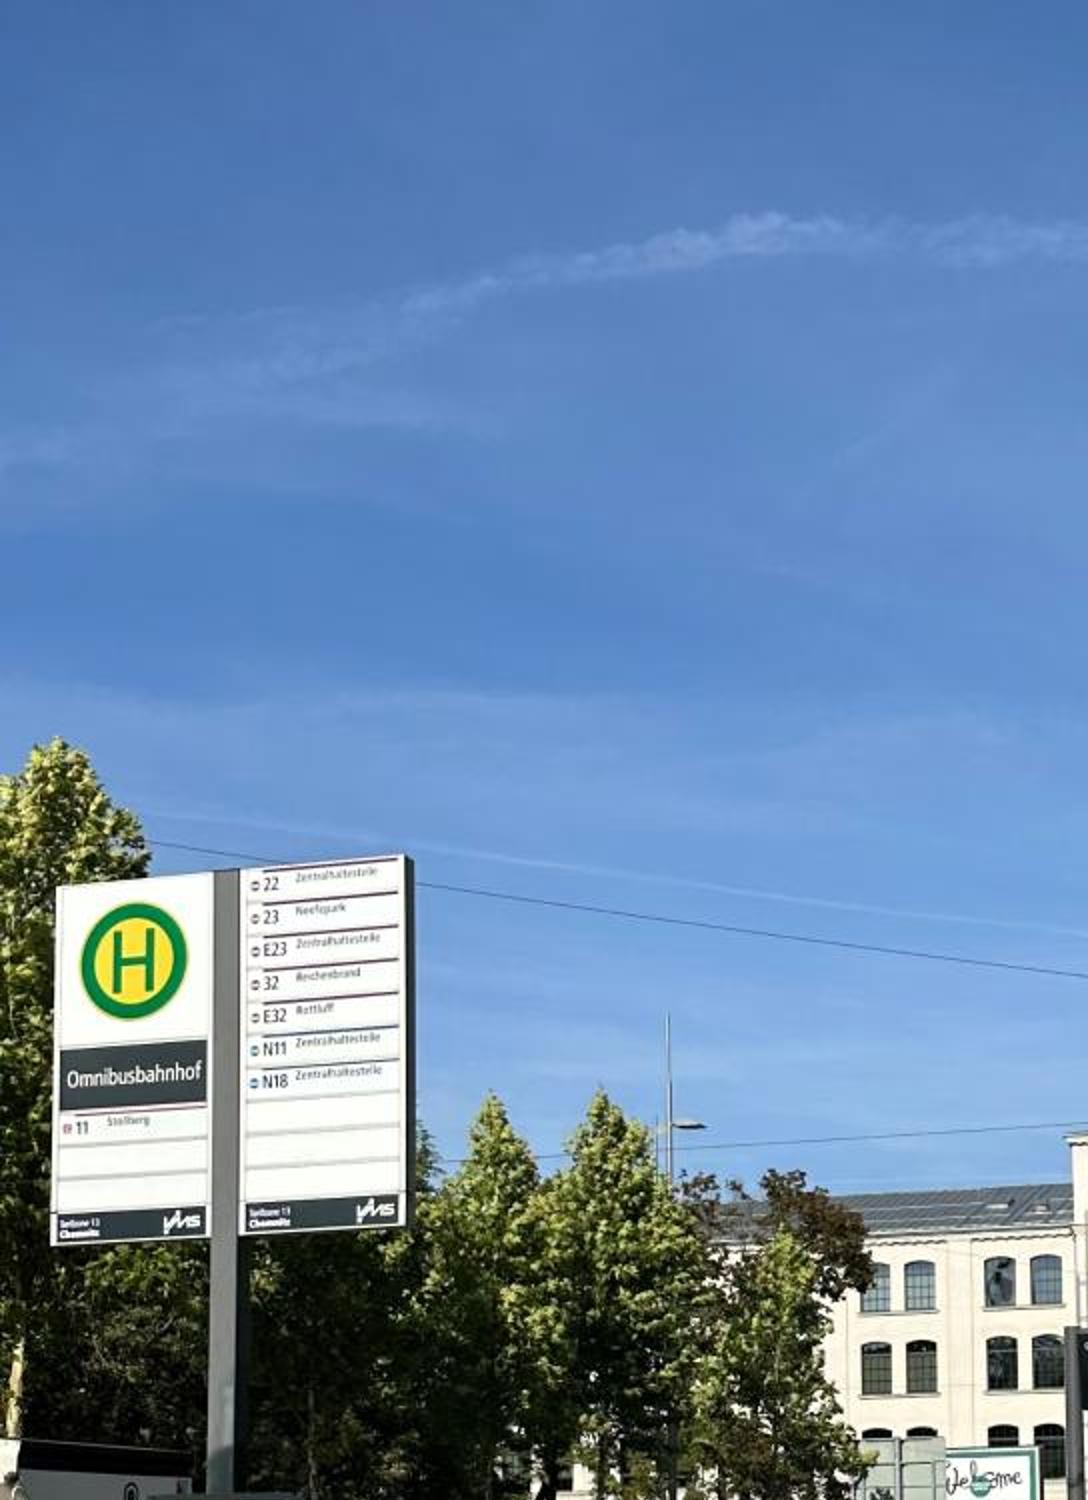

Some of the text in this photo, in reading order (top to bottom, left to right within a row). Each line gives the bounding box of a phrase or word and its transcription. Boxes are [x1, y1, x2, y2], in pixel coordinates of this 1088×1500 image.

[263, 877, 280, 892] 22
[263, 909, 280, 925] 23
[263, 941, 288, 957] E23
[112, 927, 156, 994] H
[263, 975, 280, 991] 32
[263, 1008, 288, 1024] E32
[263, 1041, 288, 1057] N11
[66, 1059, 203, 1089] Omnibusbahnhof
[262, 1074, 289, 1089] N18
[76, 1121, 89, 1135] 11
